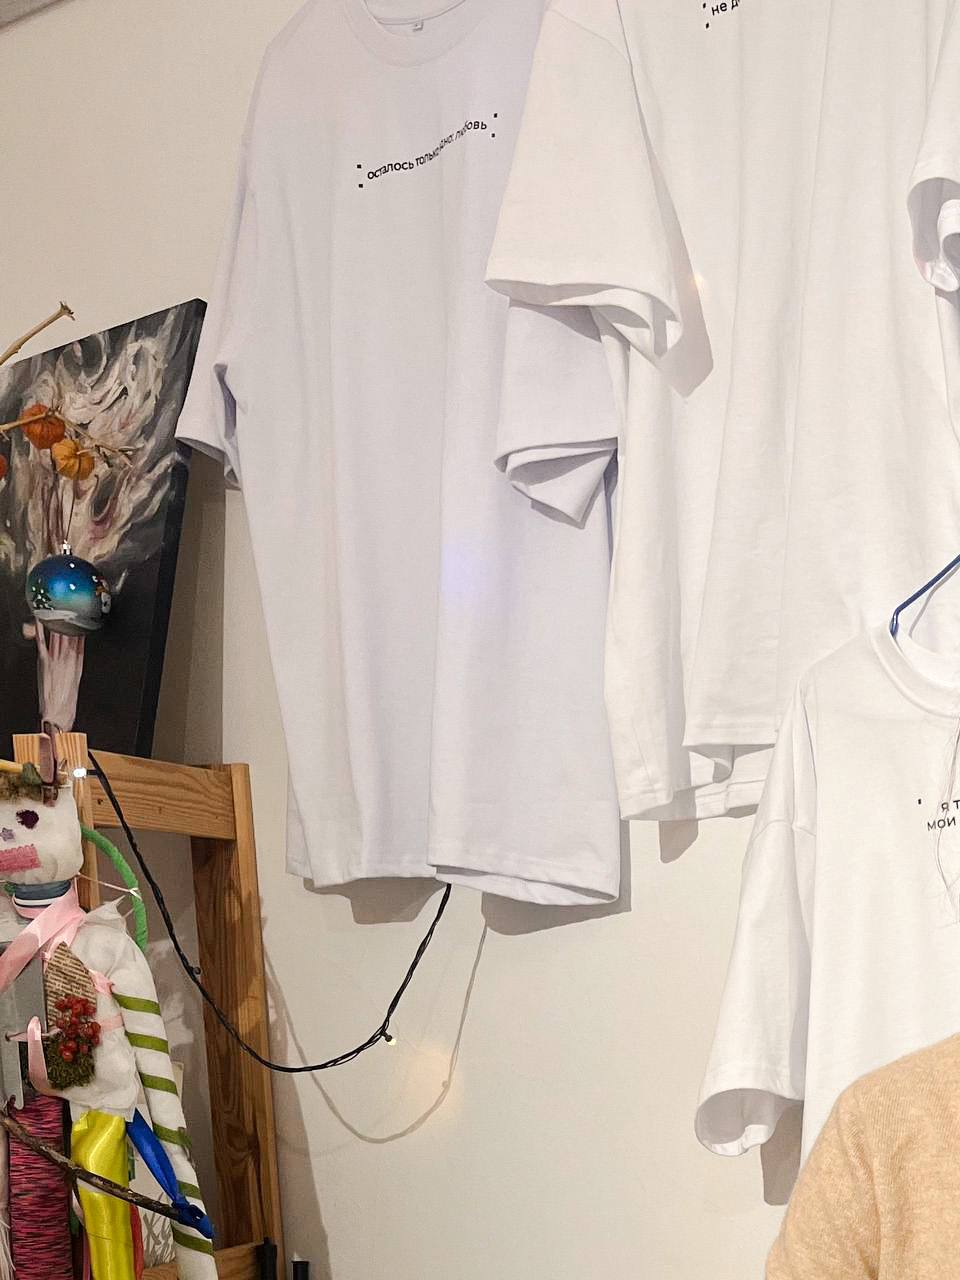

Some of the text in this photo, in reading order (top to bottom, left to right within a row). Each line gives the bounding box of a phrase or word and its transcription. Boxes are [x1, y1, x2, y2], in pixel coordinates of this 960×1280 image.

[711, 2, 727, 16] не
[367, 161, 414, 179] осталось
[941, 802, 950, 812] я
[927, 816, 956, 831] мои
